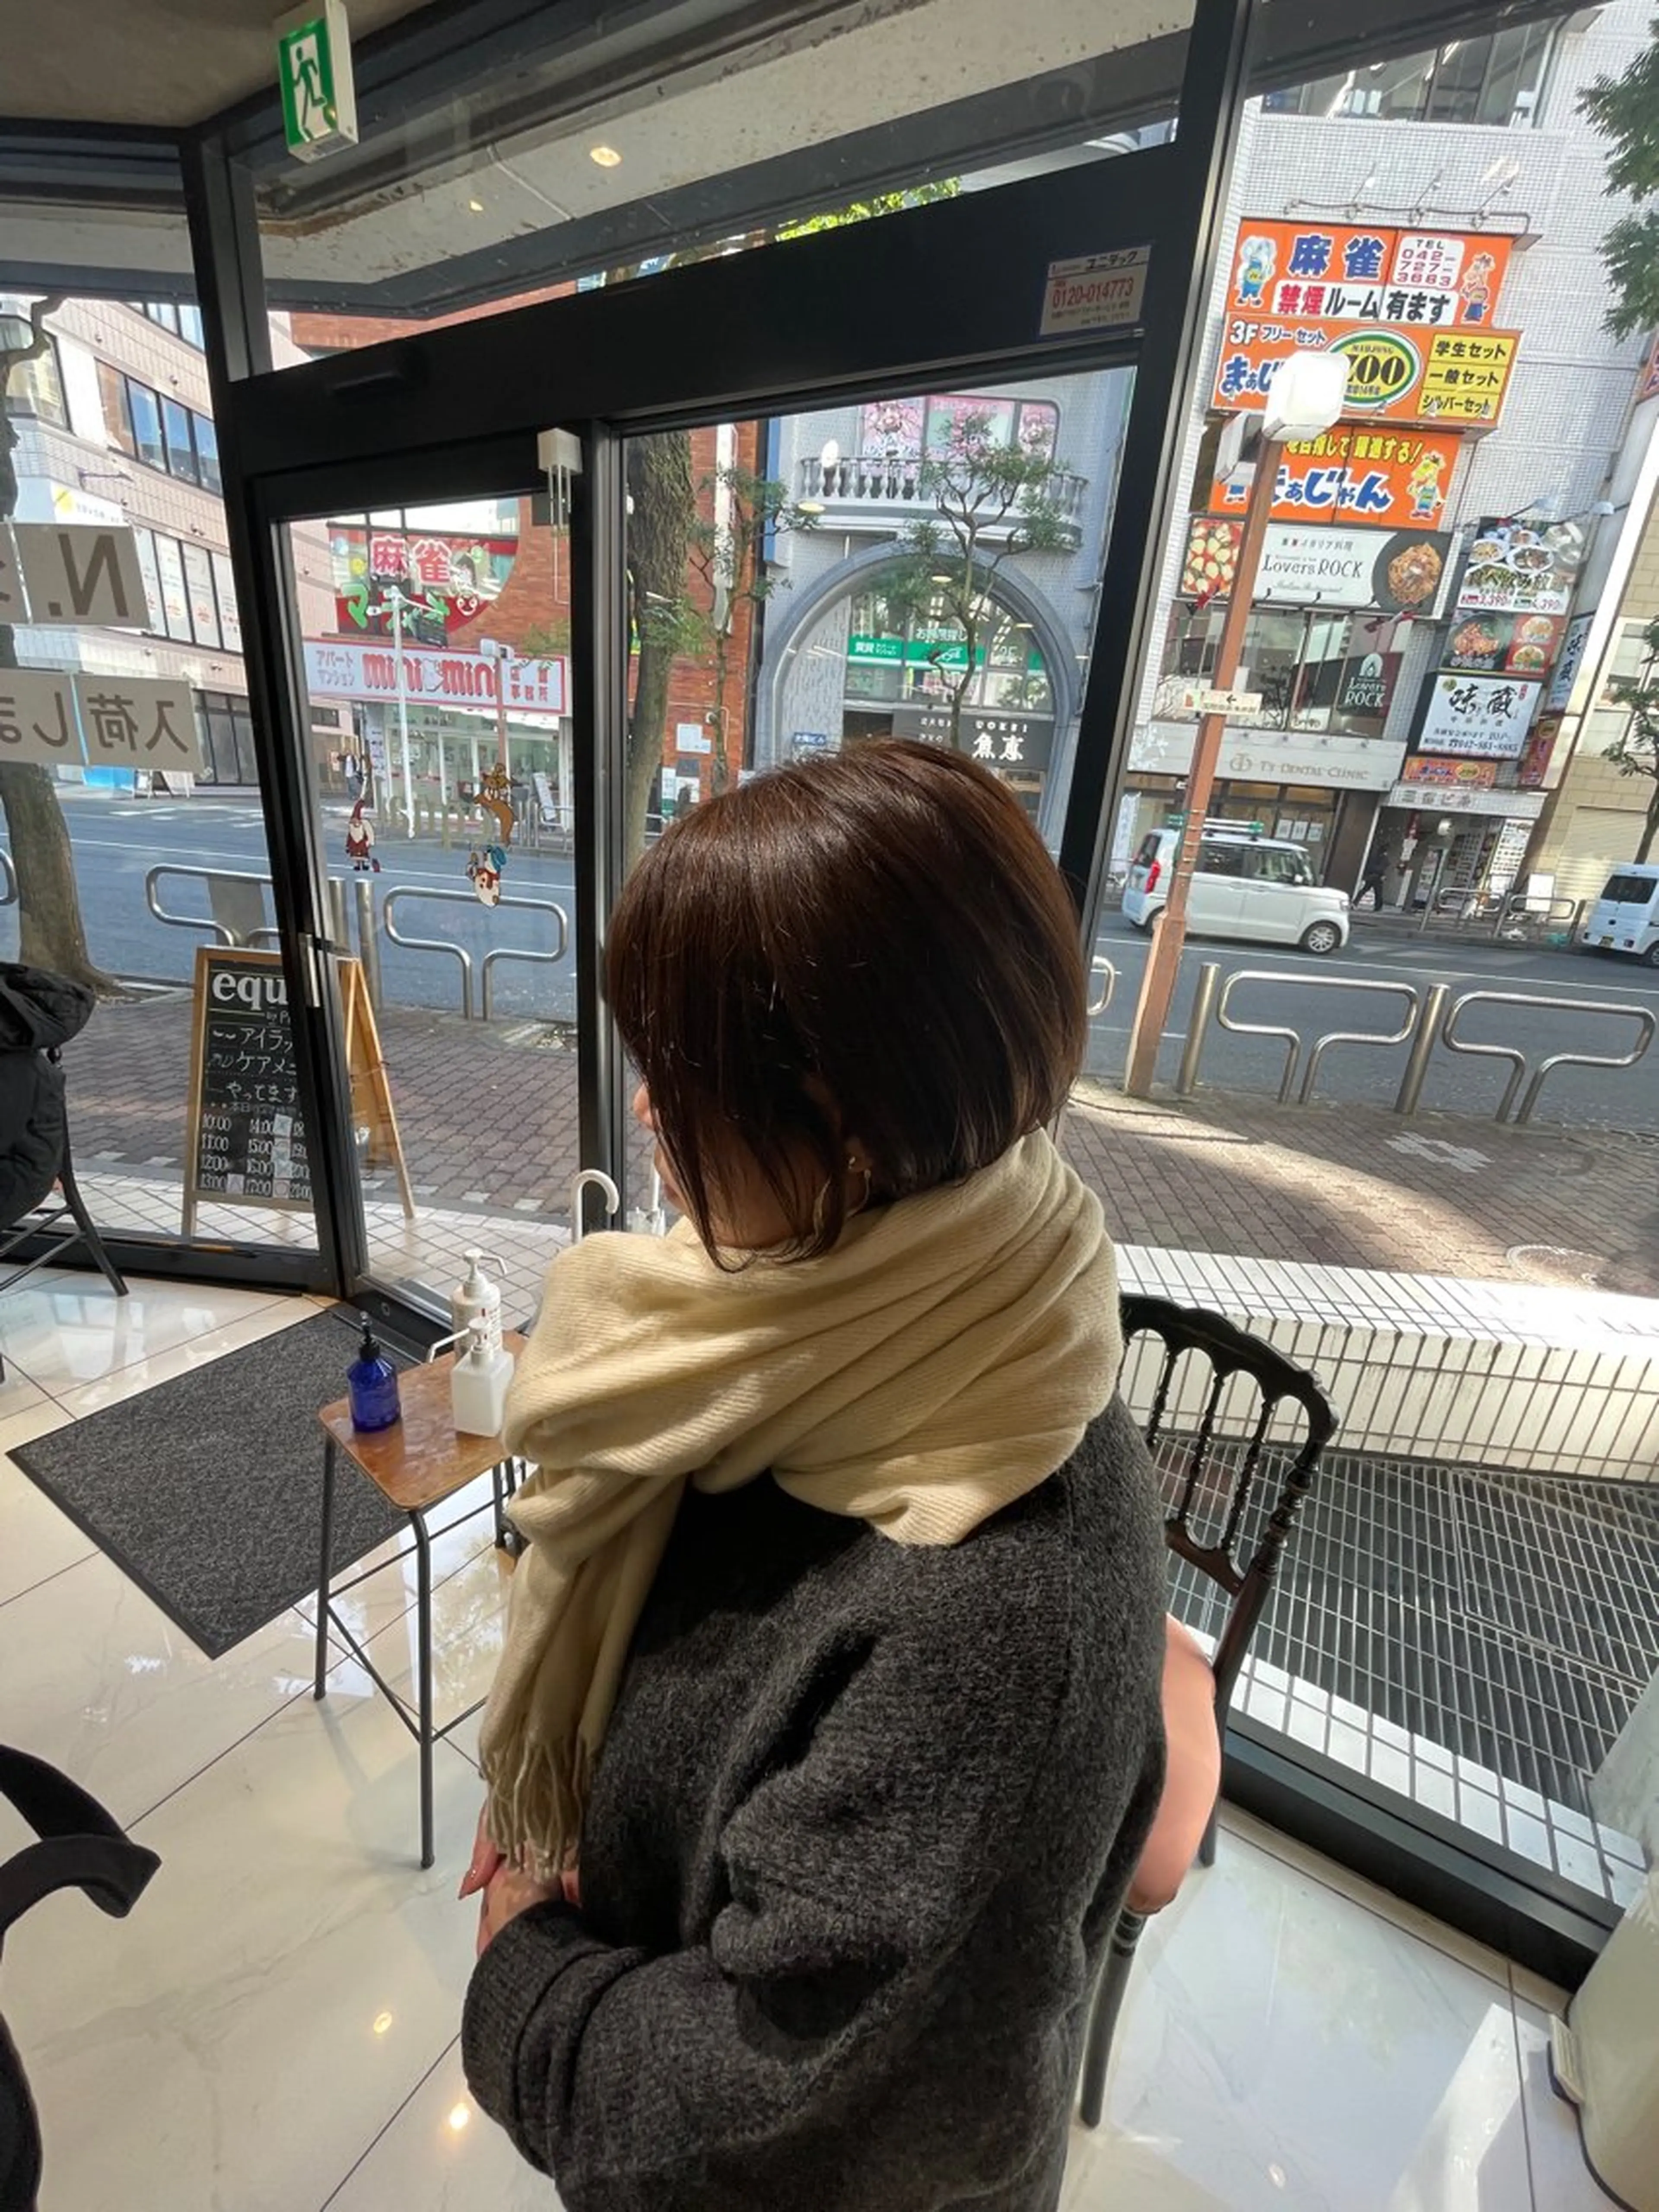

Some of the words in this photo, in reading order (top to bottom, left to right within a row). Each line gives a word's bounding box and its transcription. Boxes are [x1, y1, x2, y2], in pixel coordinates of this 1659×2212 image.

[1417, 239, 1444, 249] TEL
[1289, 235, 1385, 279] 麻雀
[1230, 321, 1259, 345] 3F
[1435, 340, 1506, 359] 学生セット
[1429, 369, 1499, 388] 一般セット
[371, 536, 452, 585] 麻雀
[1262, 554, 1315, 575] Lovers
[1317, 558, 1363, 578] ROCK
[316, 650, 354, 668] アパート
[442, 659, 498, 697] min
[1344, 690, 1386, 707] ROCK
[212, 973, 289, 1011] equ
[240, 1027, 293, 1054] アイラッ
[237, 1051, 297, 1074] ケアメニ
